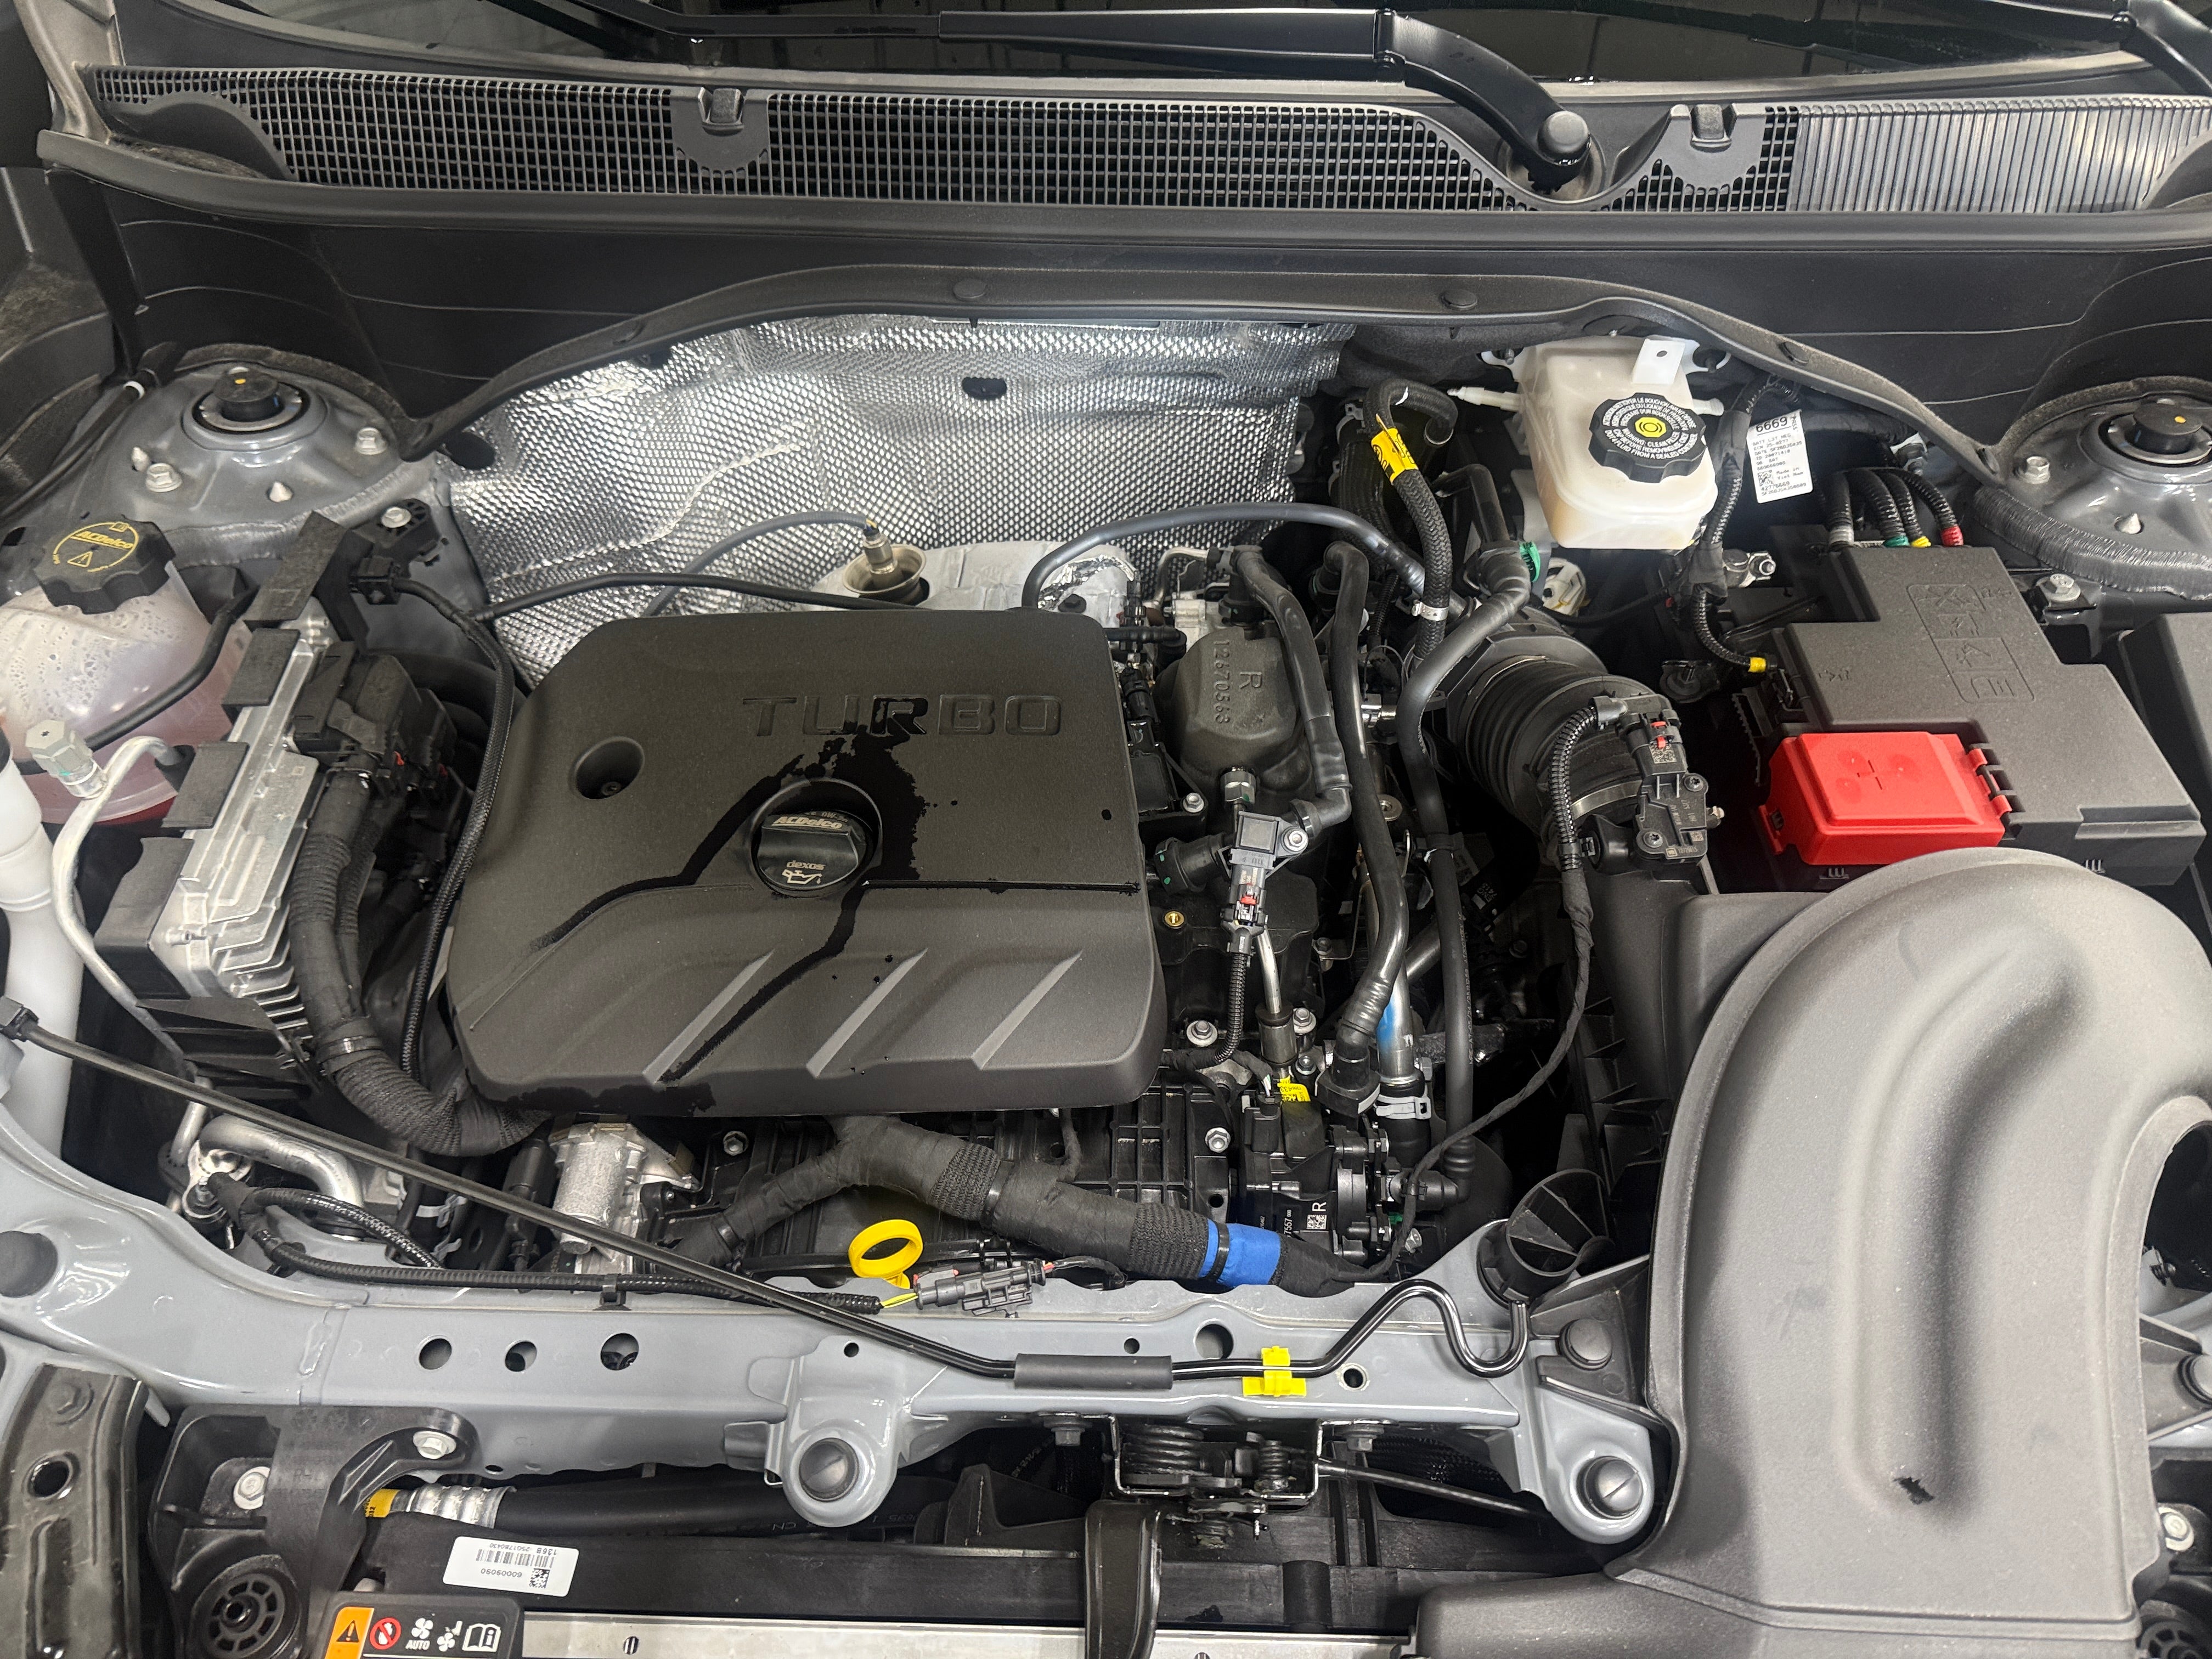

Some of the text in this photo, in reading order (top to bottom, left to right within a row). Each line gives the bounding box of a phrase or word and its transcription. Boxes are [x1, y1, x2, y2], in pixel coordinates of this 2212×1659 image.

[1644, 397, 1668, 407] BOUCHON
[1756, 416, 1788, 432] 6669
[1613, 428, 1625, 439] CAP
[1621, 438, 1642, 450] BEFORE
[1622, 427, 1646, 445] WARNING:
[1631, 448, 1650, 459] FROM
[76, 531, 134, 549] ACDelco
[1239, 671, 1262, 690] R
[742, 693, 1062, 737] TURBO
[773, 816, 843, 829] ACDelco
[786, 860, 826, 871] dexos
[1312, 1201, 1327, 1212] R
[489, 1543, 557, 1556] 136B 25G17B0430
[481, 1568, 522, 1578] 60009090
[405, 1640, 430, 1650] AUTO
